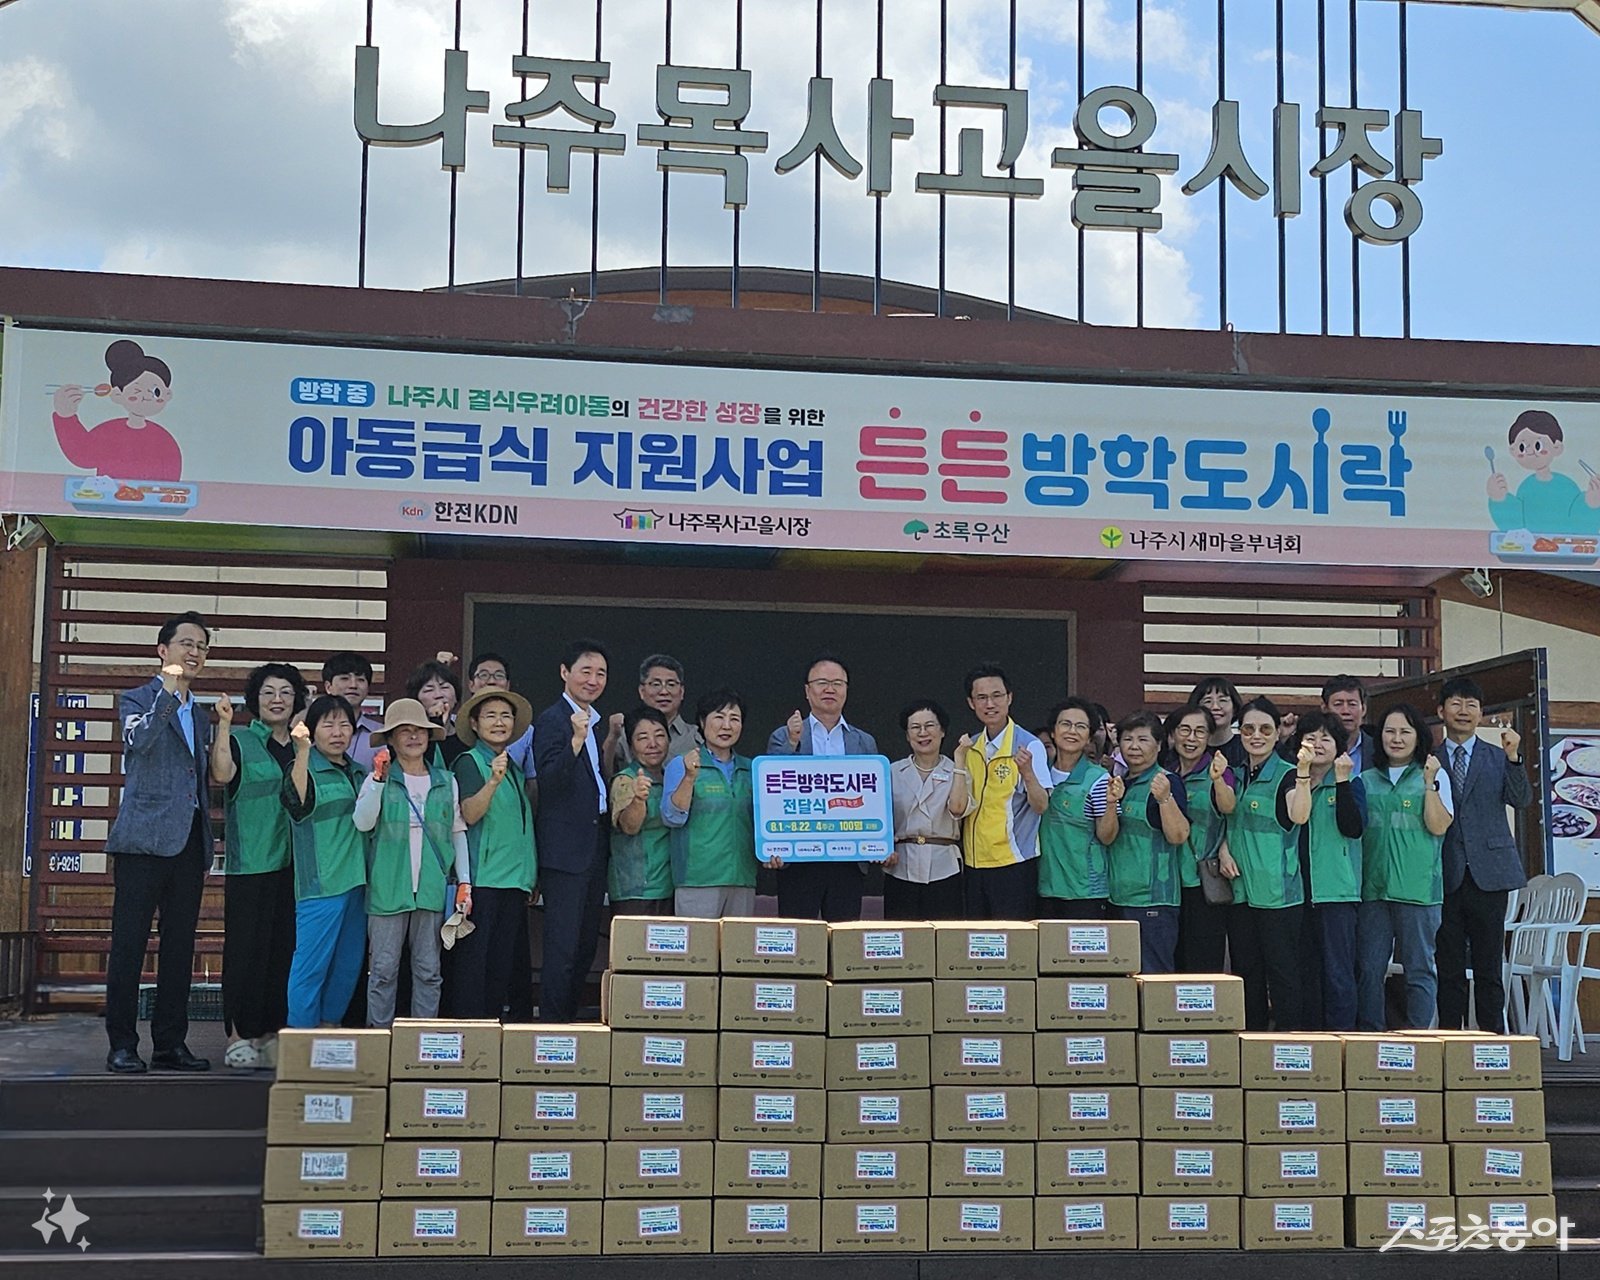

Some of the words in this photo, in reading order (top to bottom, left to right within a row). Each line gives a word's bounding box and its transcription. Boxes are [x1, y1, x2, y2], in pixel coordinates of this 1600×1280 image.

[354, 45, 1443, 244] 나주목사고을시장
[299, 381, 341, 402] 방학
[347, 383, 367, 405] 중
[388, 385, 459, 409] 나주시
[469, 389, 629, 418] 결식우려아동의
[638, 397, 708, 422] 건강한
[715, 401, 782, 426] 성장을
[788, 407, 825, 426] 위한
[289, 416, 549, 486] 아동급식
[574, 431, 823, 497] 지원사업
[435, 501, 518, 524] 한전KDN
[668, 512, 812, 537] 나주목사고을시장
[933, 521, 1010, 543] 초록우산
[766, 770, 877, 794] 든든방학도시락
[783, 798, 827, 815] 전달식
